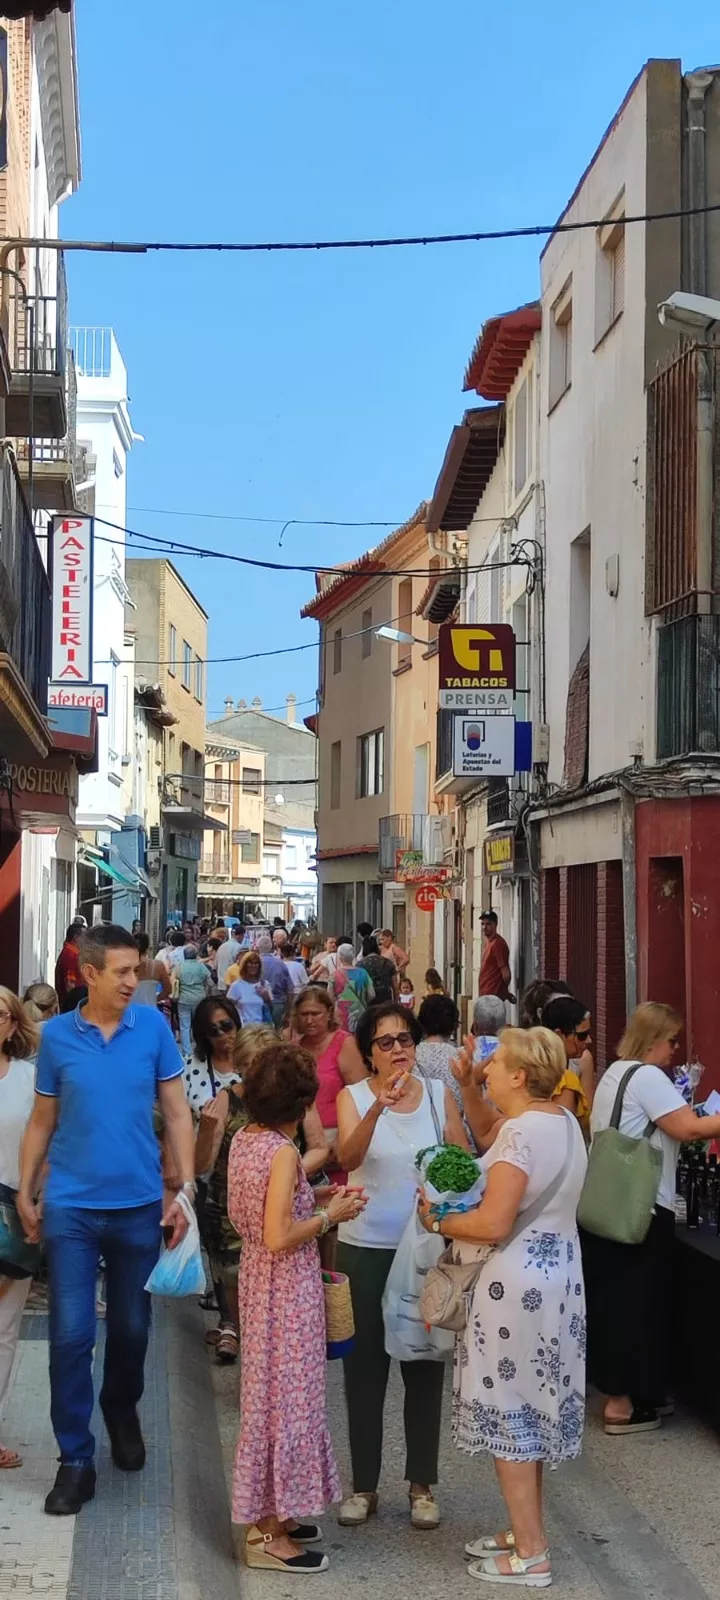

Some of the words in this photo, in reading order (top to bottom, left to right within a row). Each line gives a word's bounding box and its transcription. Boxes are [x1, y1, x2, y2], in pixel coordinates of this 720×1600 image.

[59, 519, 85, 679] PASTELERIA
[445, 678, 508, 687] TABACOS
[49, 689, 104, 709] afetería
[445, 693, 508, 705] PRENSA
